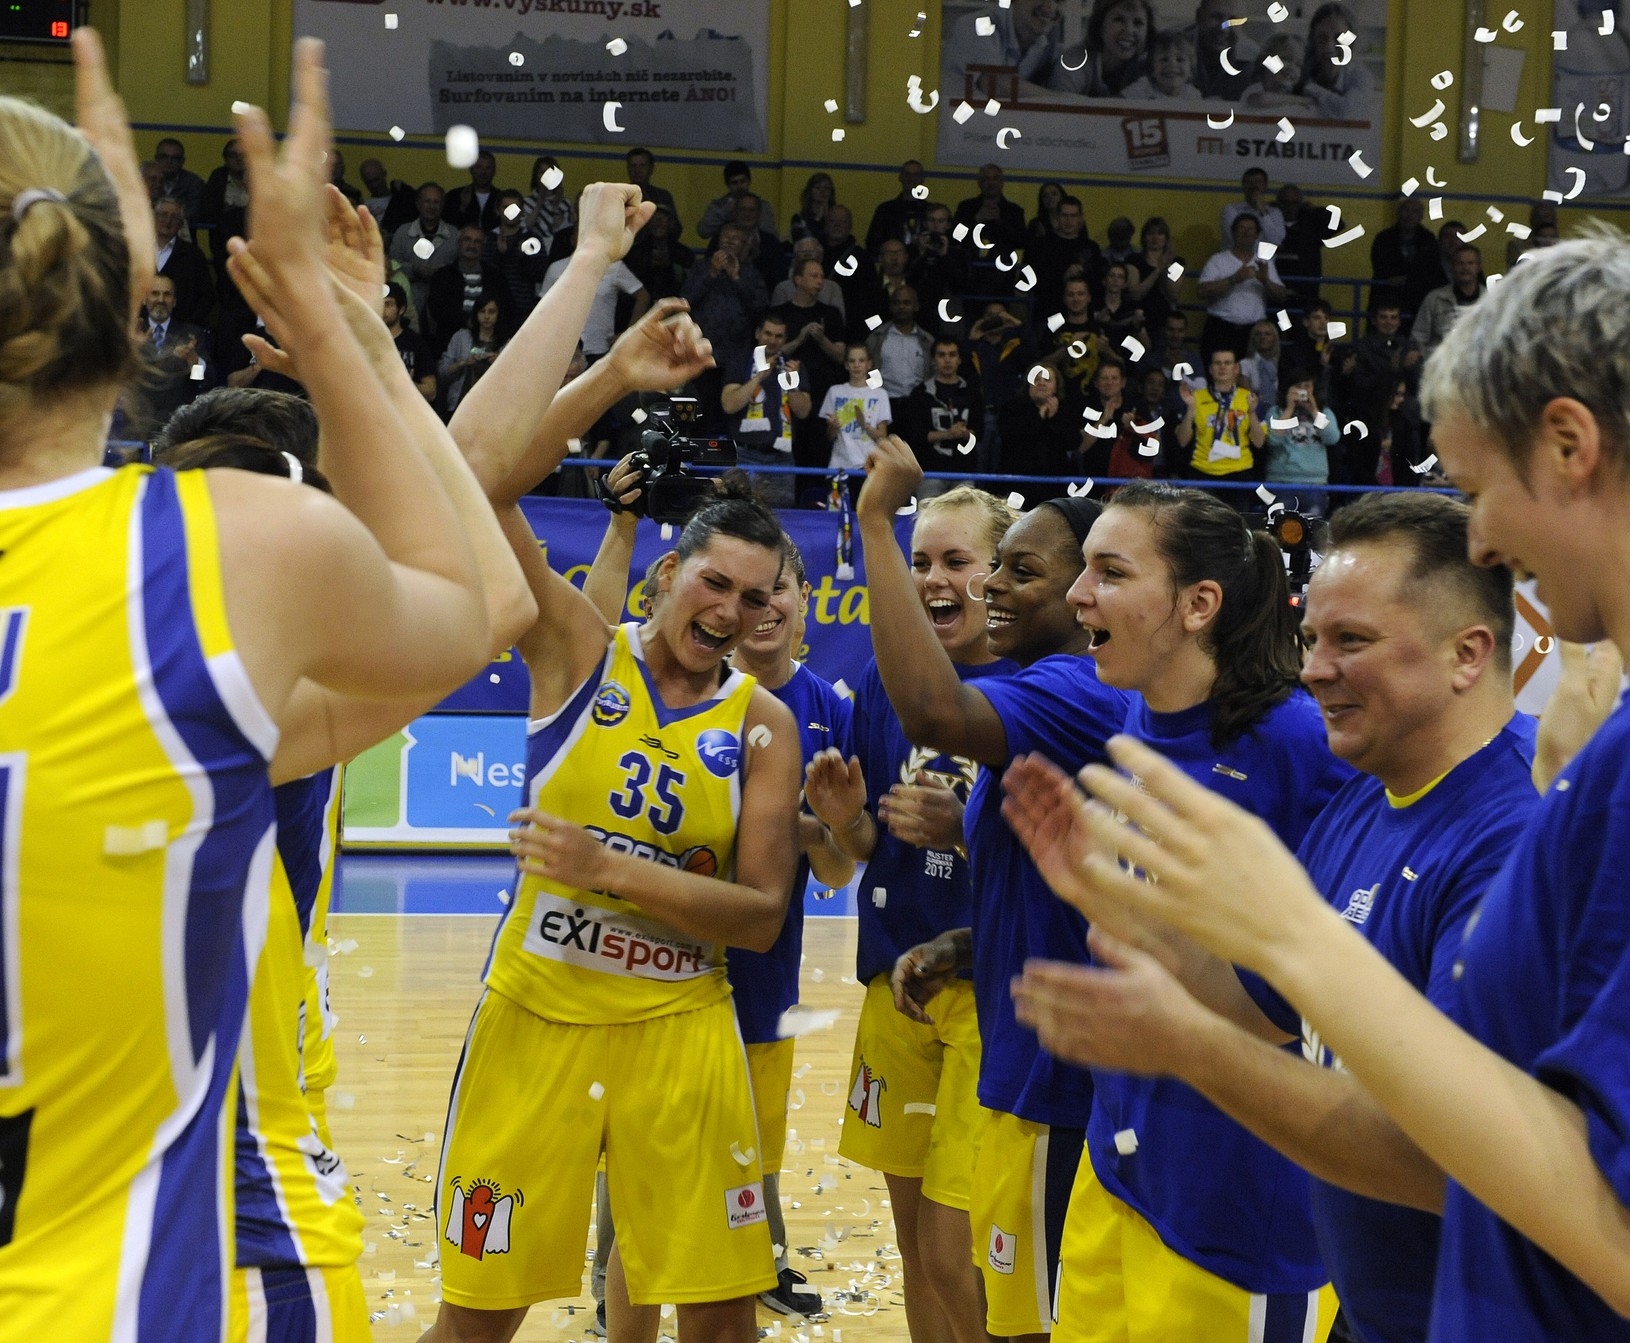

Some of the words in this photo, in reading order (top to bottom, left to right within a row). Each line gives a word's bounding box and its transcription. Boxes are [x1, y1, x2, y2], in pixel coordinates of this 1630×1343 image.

[426, 0, 662, 20] w.vyskumy.sk
[538, 73, 548, 82] v
[552, 70, 622, 82] novinách
[439, 88, 555, 103] Surfovaním
[560, 92, 584, 103] na
[589, 88, 680, 103] internete
[685, 84, 736, 102] ÁNO!
[1127, 118, 1162, 147] 15
[1236, 138, 1359, 162] STABILITA
[610, 751, 686, 835] 35
[924, 861, 953, 880] 2012
